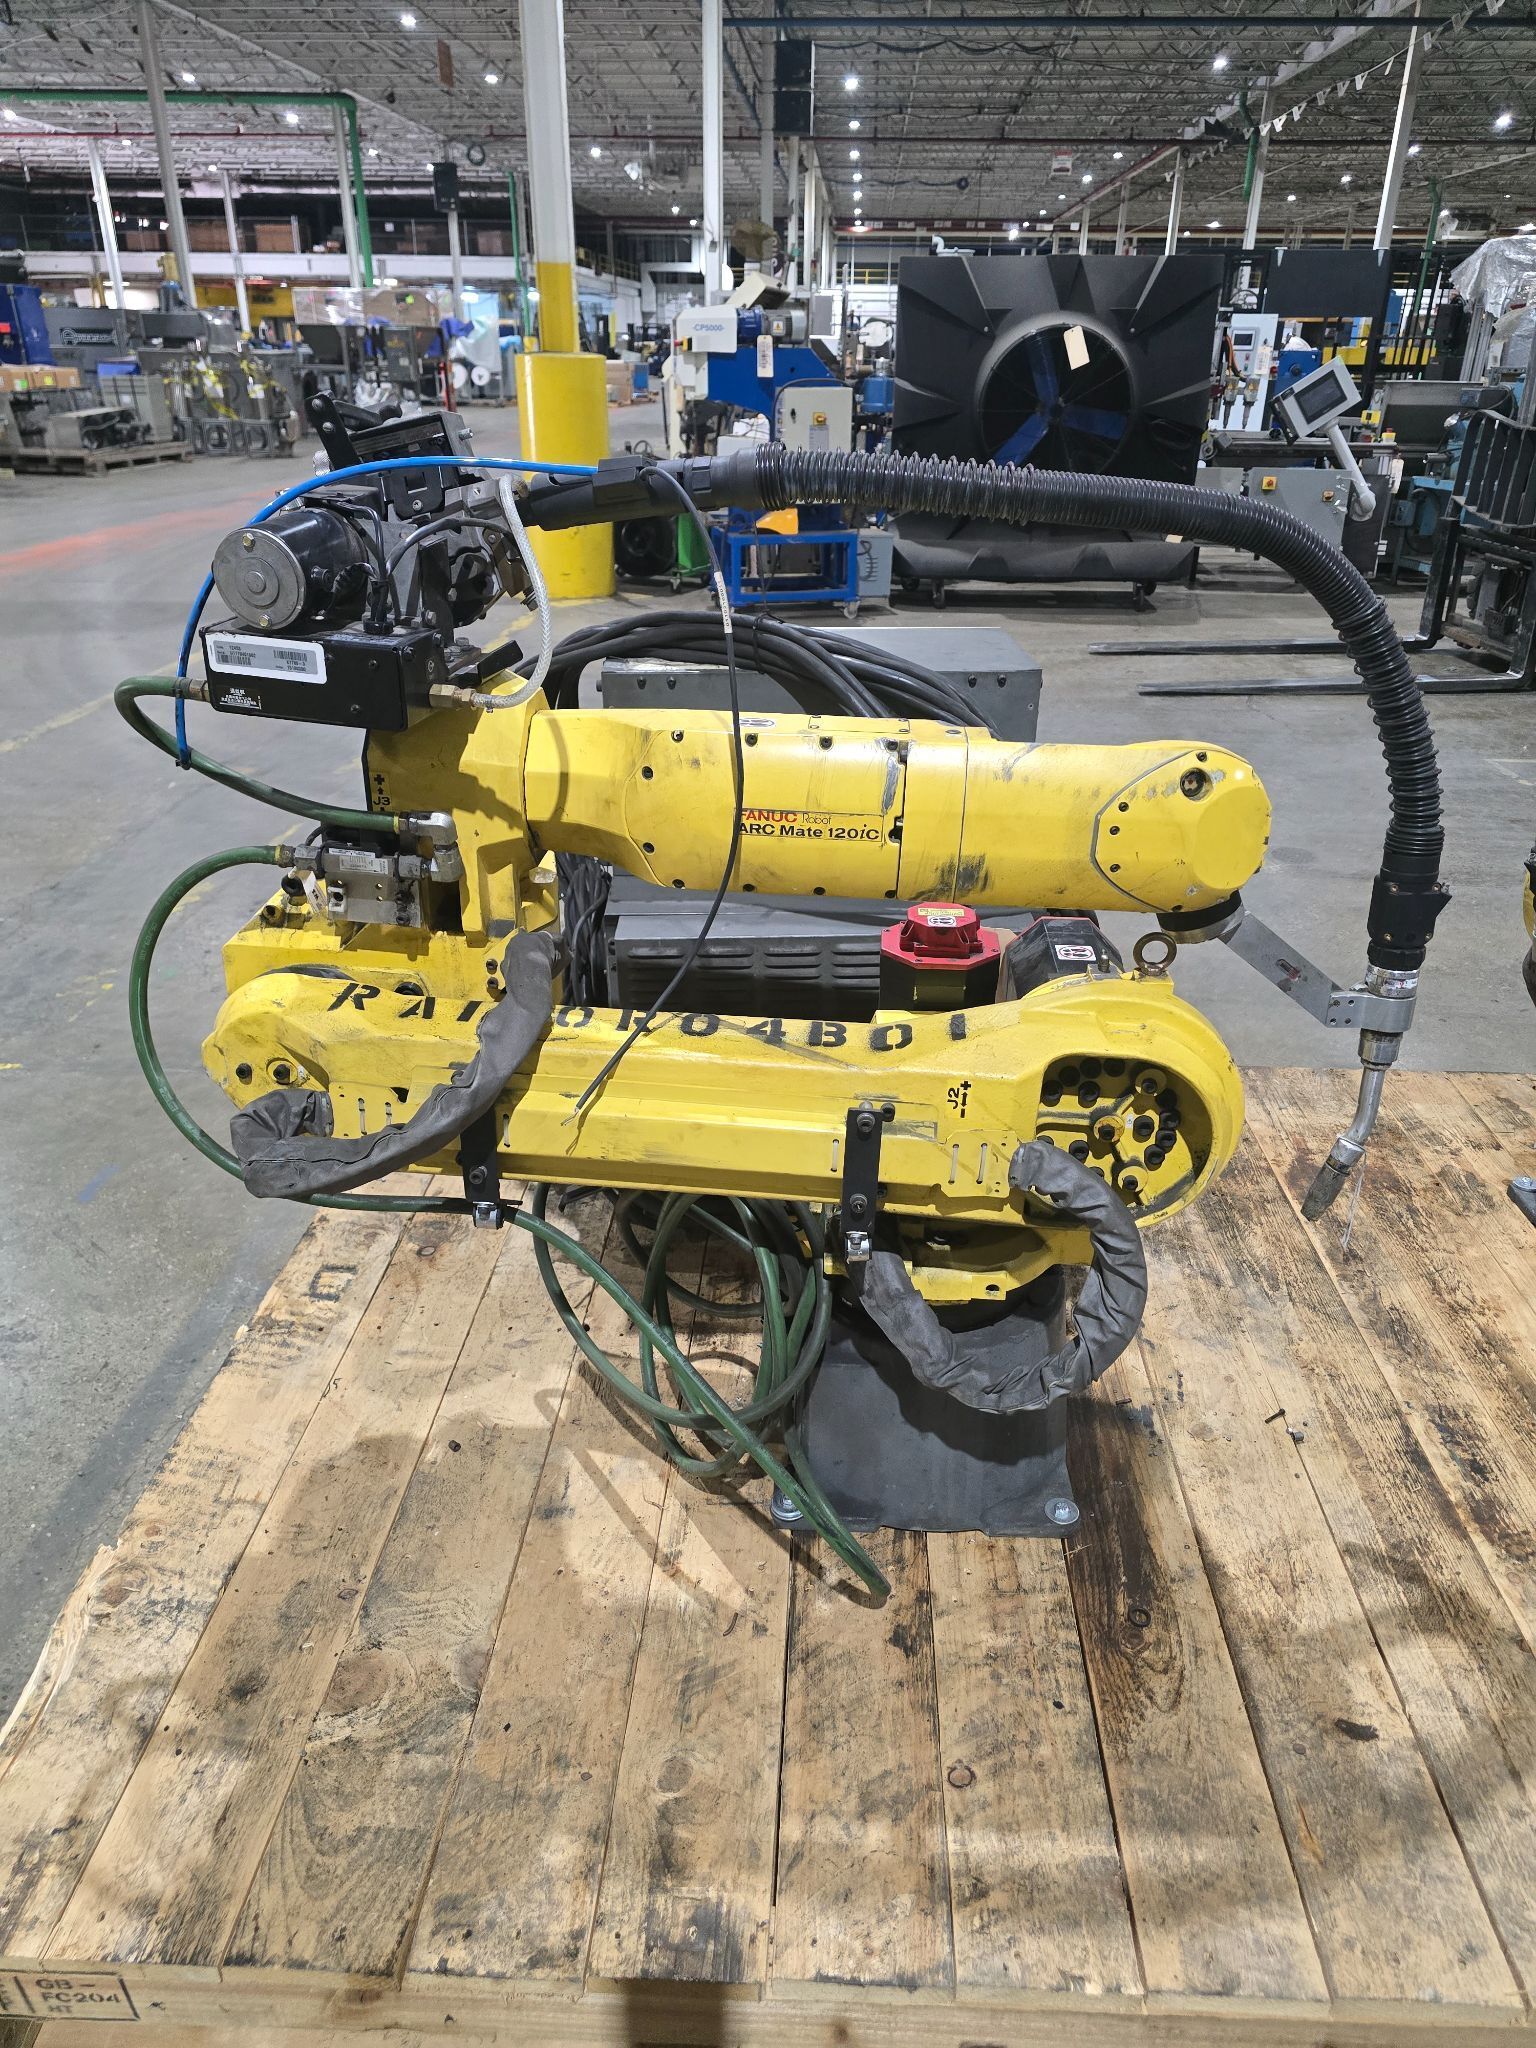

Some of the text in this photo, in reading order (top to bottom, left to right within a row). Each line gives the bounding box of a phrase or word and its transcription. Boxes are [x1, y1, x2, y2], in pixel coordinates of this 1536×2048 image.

[373, 796, 391, 806] J3
[741, 810, 832, 825] FANUC Robot
[739, 823, 880, 840] ARC Mate 120iC
[947, 1087, 960, 1110] J2
[41, 1992, 120, 2003] FC204
[48, 2005, 73, 2013] HT
